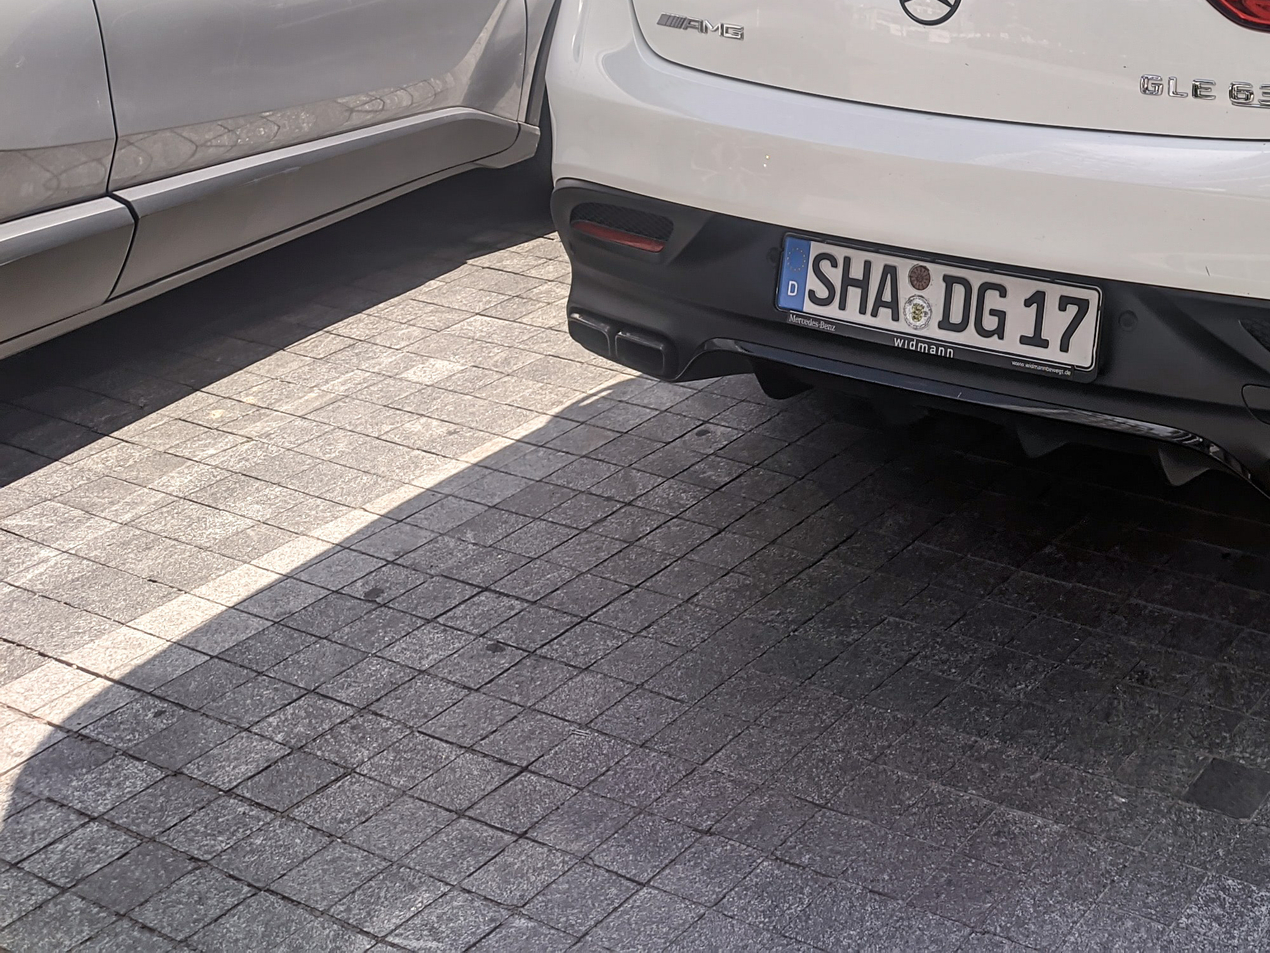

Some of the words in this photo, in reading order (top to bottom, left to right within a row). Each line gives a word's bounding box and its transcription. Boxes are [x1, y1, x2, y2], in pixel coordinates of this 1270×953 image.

[683, 14, 745, 41] AMG
[1139, 74, 1216, 101] GLE
[787, 281, 798, 296] D
[807, 252, 900, 322] SHA
[937, 273, 1007, 340] DG
[1019, 290, 1090, 353] 17
[788, 313, 837, 332] Mercedes-Benz
[893, 337, 955, 359] widmann
